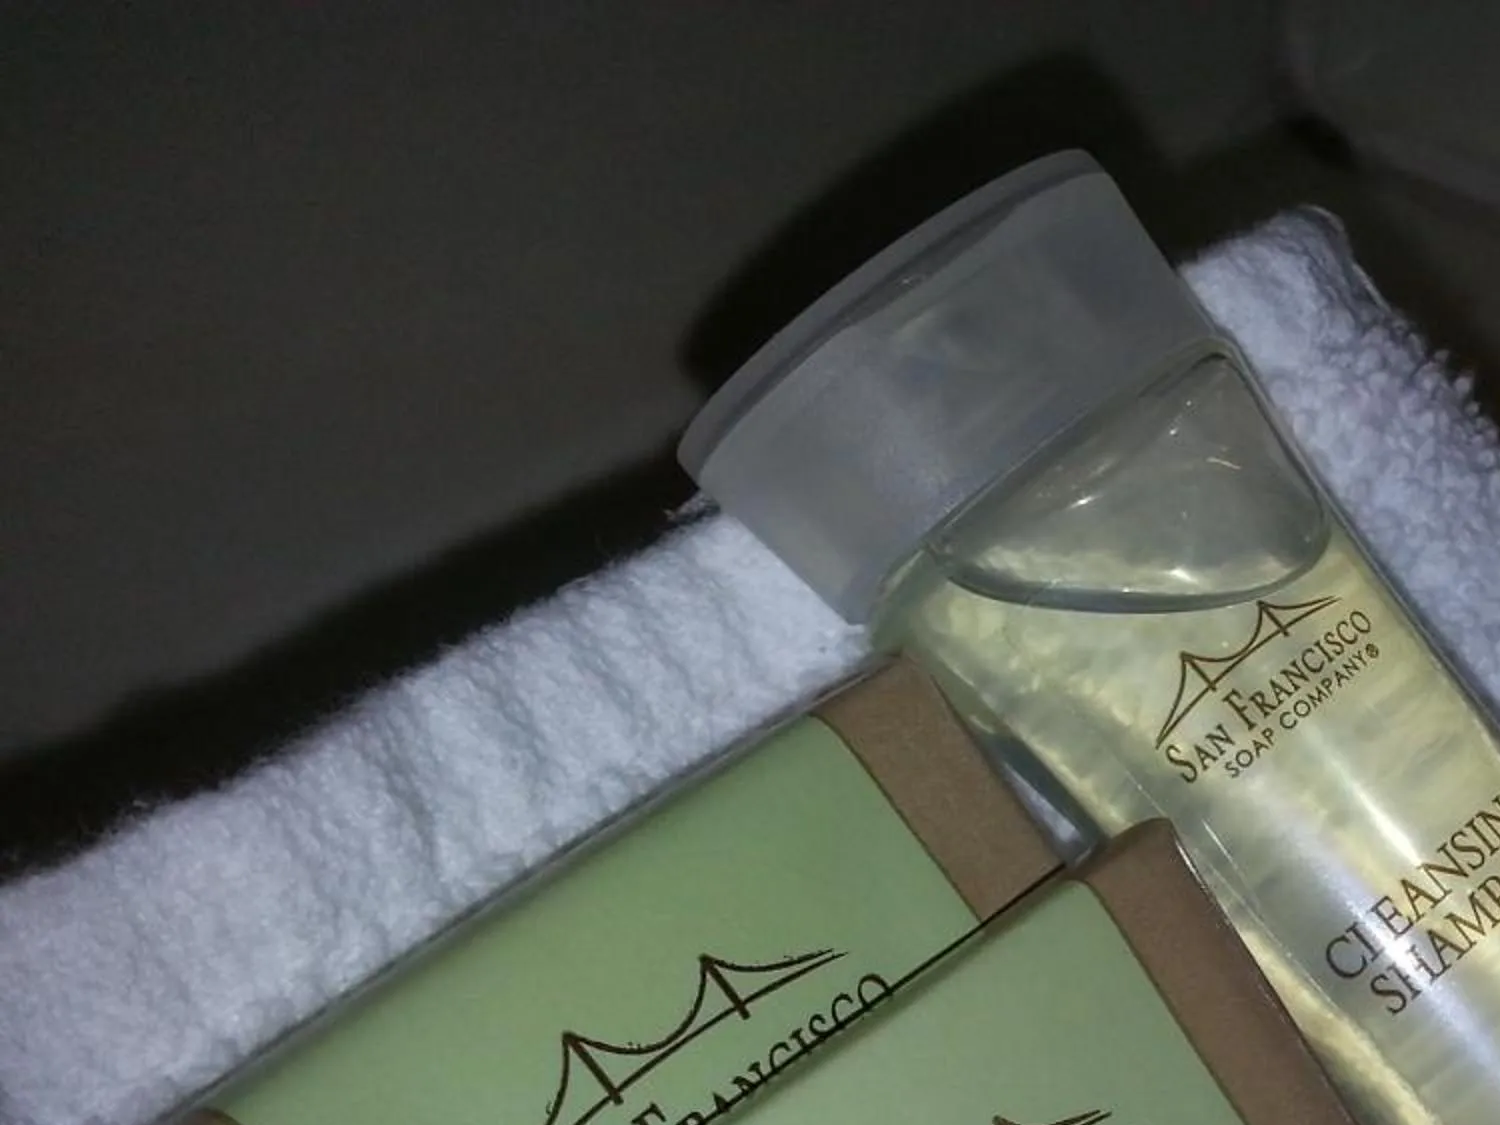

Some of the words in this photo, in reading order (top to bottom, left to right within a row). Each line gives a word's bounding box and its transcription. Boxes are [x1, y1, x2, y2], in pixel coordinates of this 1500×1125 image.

[1167, 723, 1235, 783] SAN
[1223, 611, 1371, 731] FRANCISCO
[1225, 728, 1274, 778] SOAP
